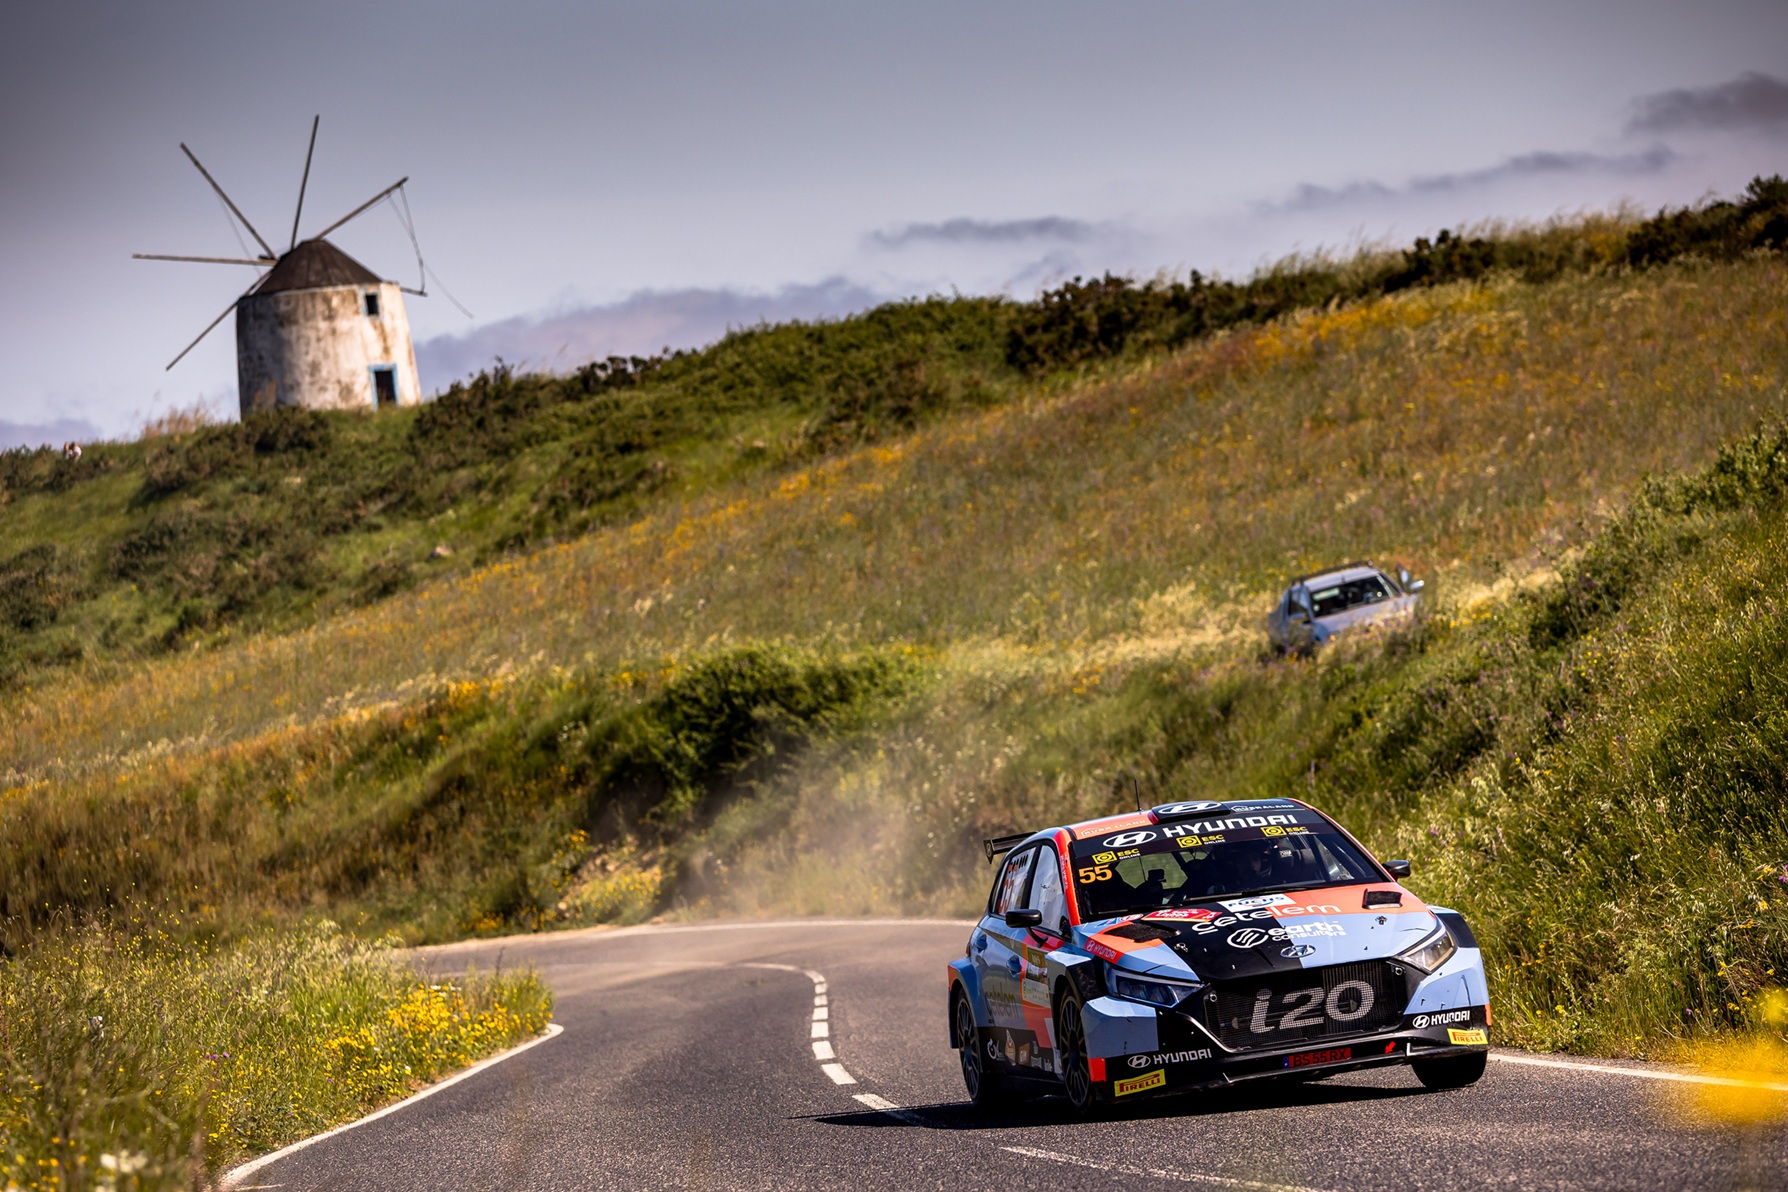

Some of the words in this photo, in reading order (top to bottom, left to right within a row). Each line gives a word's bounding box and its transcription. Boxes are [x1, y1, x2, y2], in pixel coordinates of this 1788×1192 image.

[1162, 814, 1298, 838] HYUNDAI
[1201, 834, 1224, 842] ESC
[1117, 848, 1140, 857] ESC
[1078, 864, 1113, 884] 55
[1191, 904, 1342, 931] cetelem
[1267, 921, 1345, 936] earth
[1094, 944, 1117, 960] HYUNDAI
[1250, 980, 1375, 1034] i20
[1431, 1010, 1470, 1025] HYUNDAI
[1452, 1031, 1483, 1042] PIRELLI
[1153, 1048, 1212, 1065] HYUNDAI
[1293, 1054, 1310, 1067] BS
[1312, 1051, 1327, 1064] 55
[1329, 1048, 1347, 1061] RX
[1119, 1073, 1160, 1093] PIRELLI
